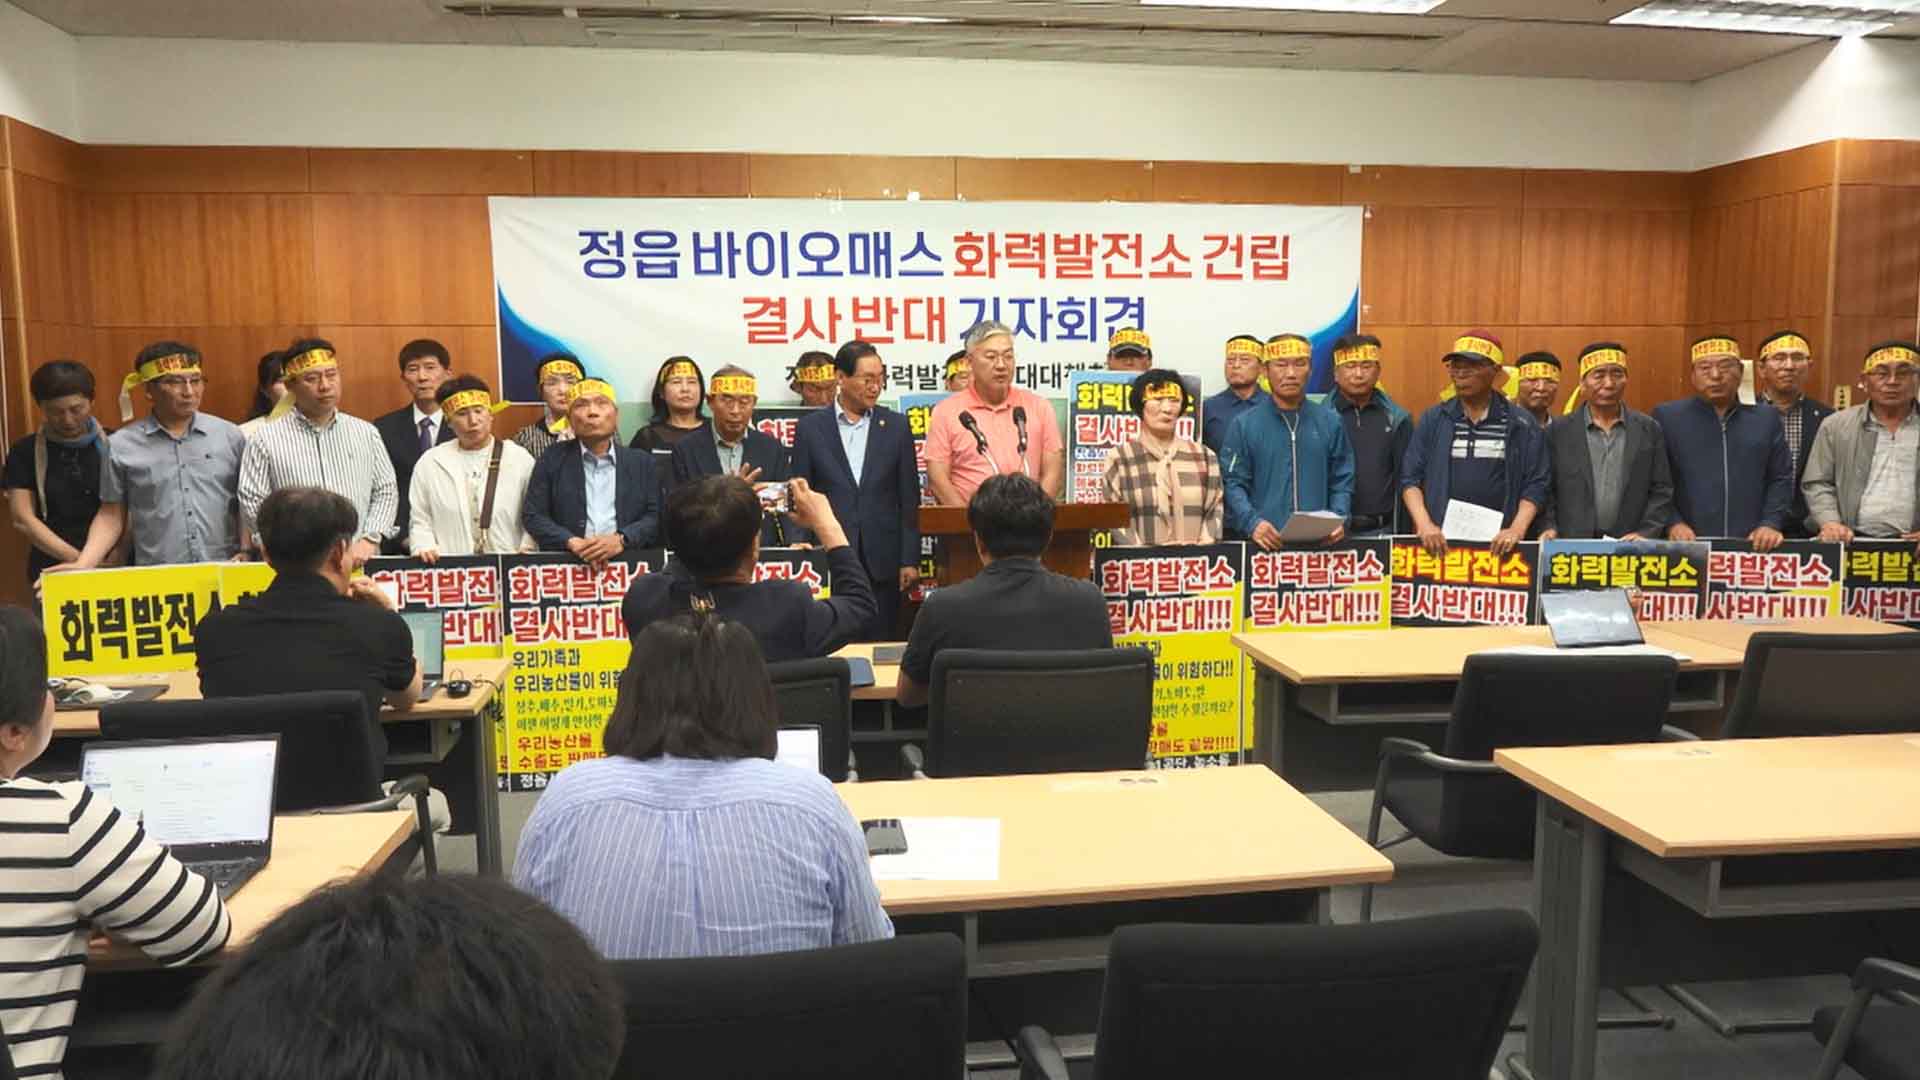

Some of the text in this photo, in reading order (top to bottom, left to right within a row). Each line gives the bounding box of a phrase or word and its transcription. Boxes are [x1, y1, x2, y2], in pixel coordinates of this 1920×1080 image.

[578, 231, 1289, 279] 정읍 바이오매스 화력발전소 건립
[510, 563, 650, 602] 화력발전
[1103, 557, 1234, 594] 화력발전소
[1252, 551, 1383, 586] 화력발전소
[1392, 546, 1530, 584] 화력발전소
[1550, 553, 1698, 587] 화력발전소
[1709, 552, 1831, 588] 력발전소
[1844, 552, 1920, 582] 력발
[1252, 592, 1381, 625] 결사반대!!!
[1392, 585, 1527, 623] 결사반대!!!
